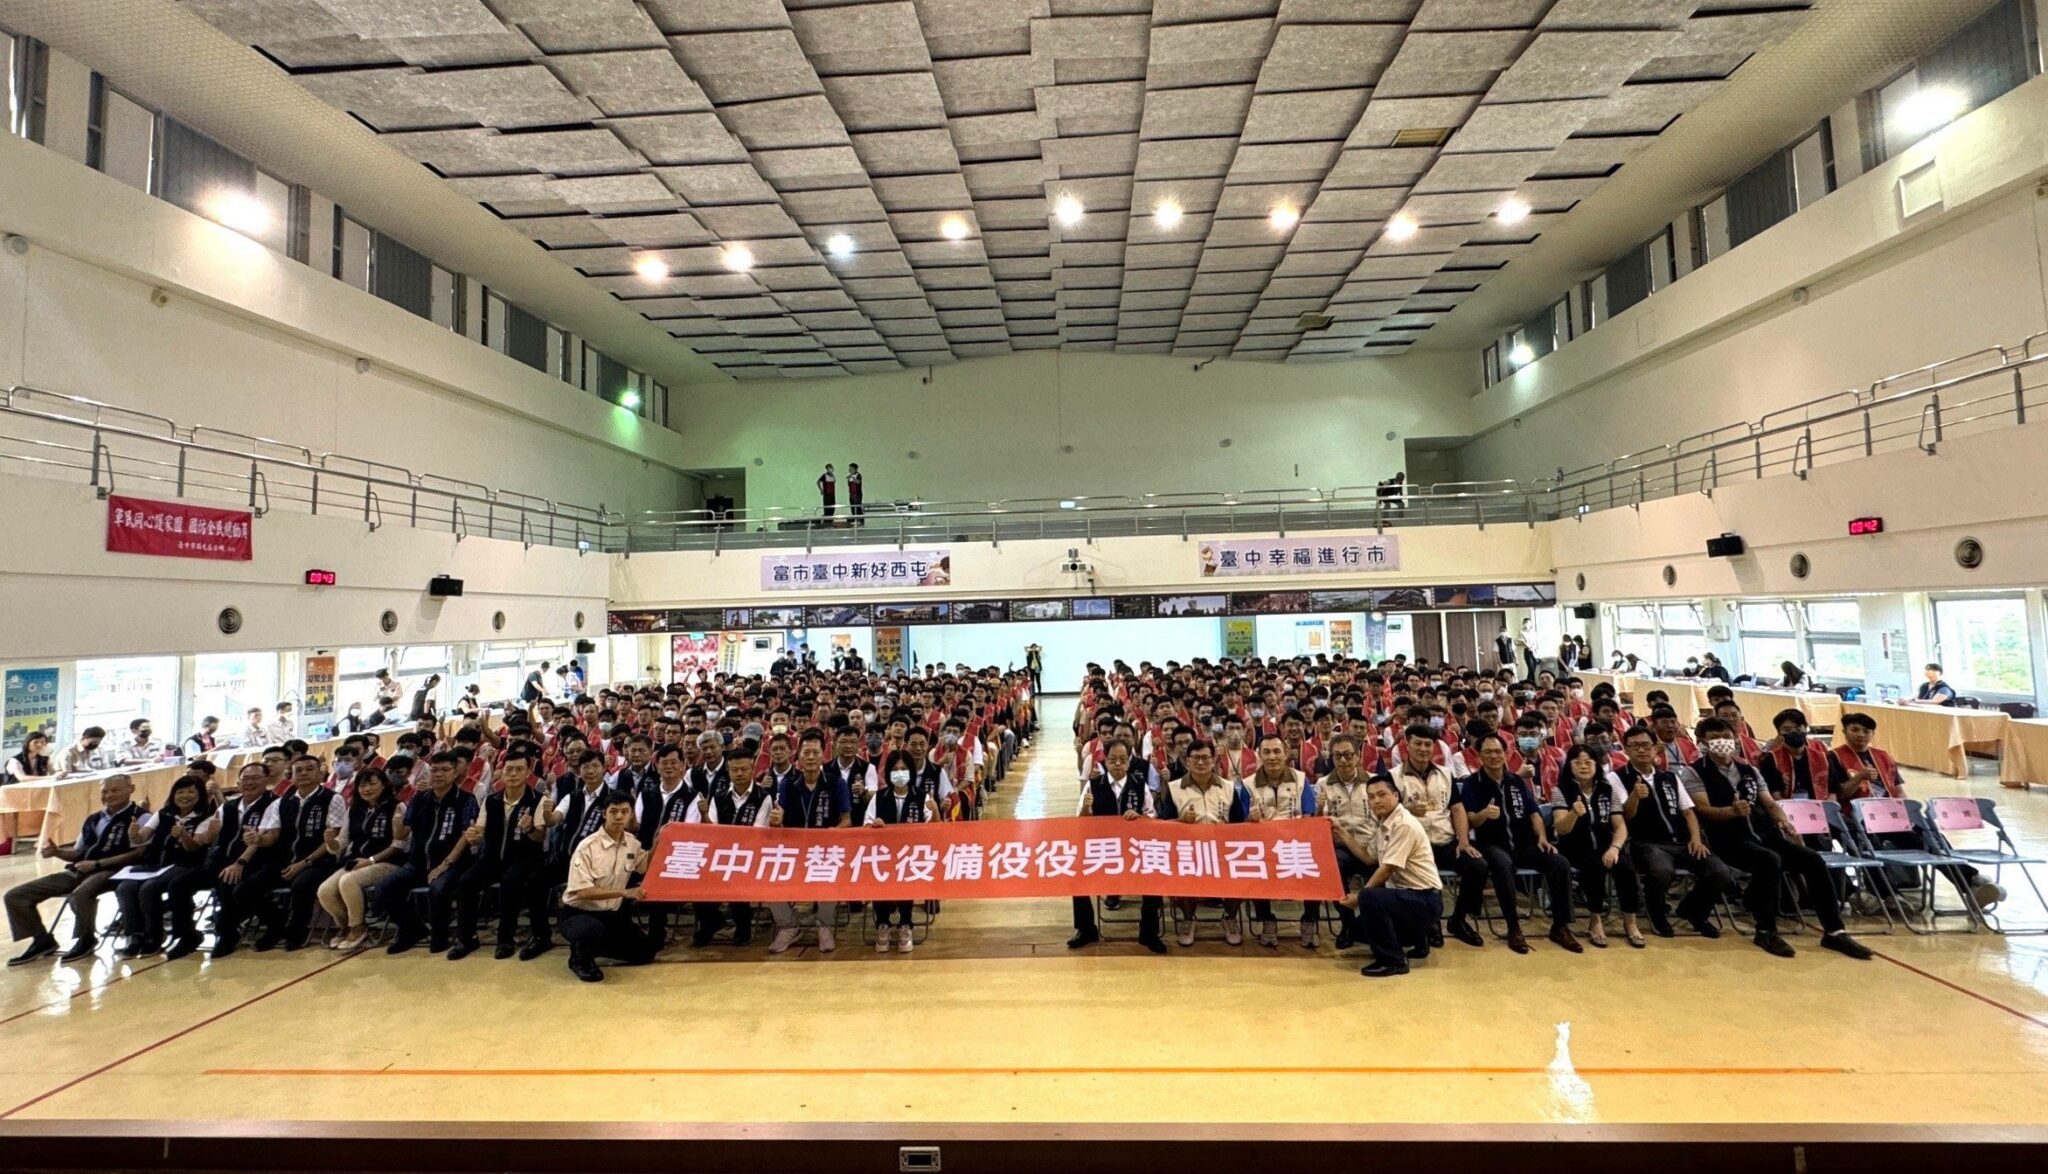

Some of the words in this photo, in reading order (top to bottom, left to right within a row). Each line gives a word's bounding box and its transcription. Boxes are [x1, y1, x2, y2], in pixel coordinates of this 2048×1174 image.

[1220, 545, 1385, 568] 臺中幸福進行市
[773, 561, 928, 582] 富市臺中新好西屯
[660, 837, 1321, 884] 臺中市替代役備役役男演訓召集
